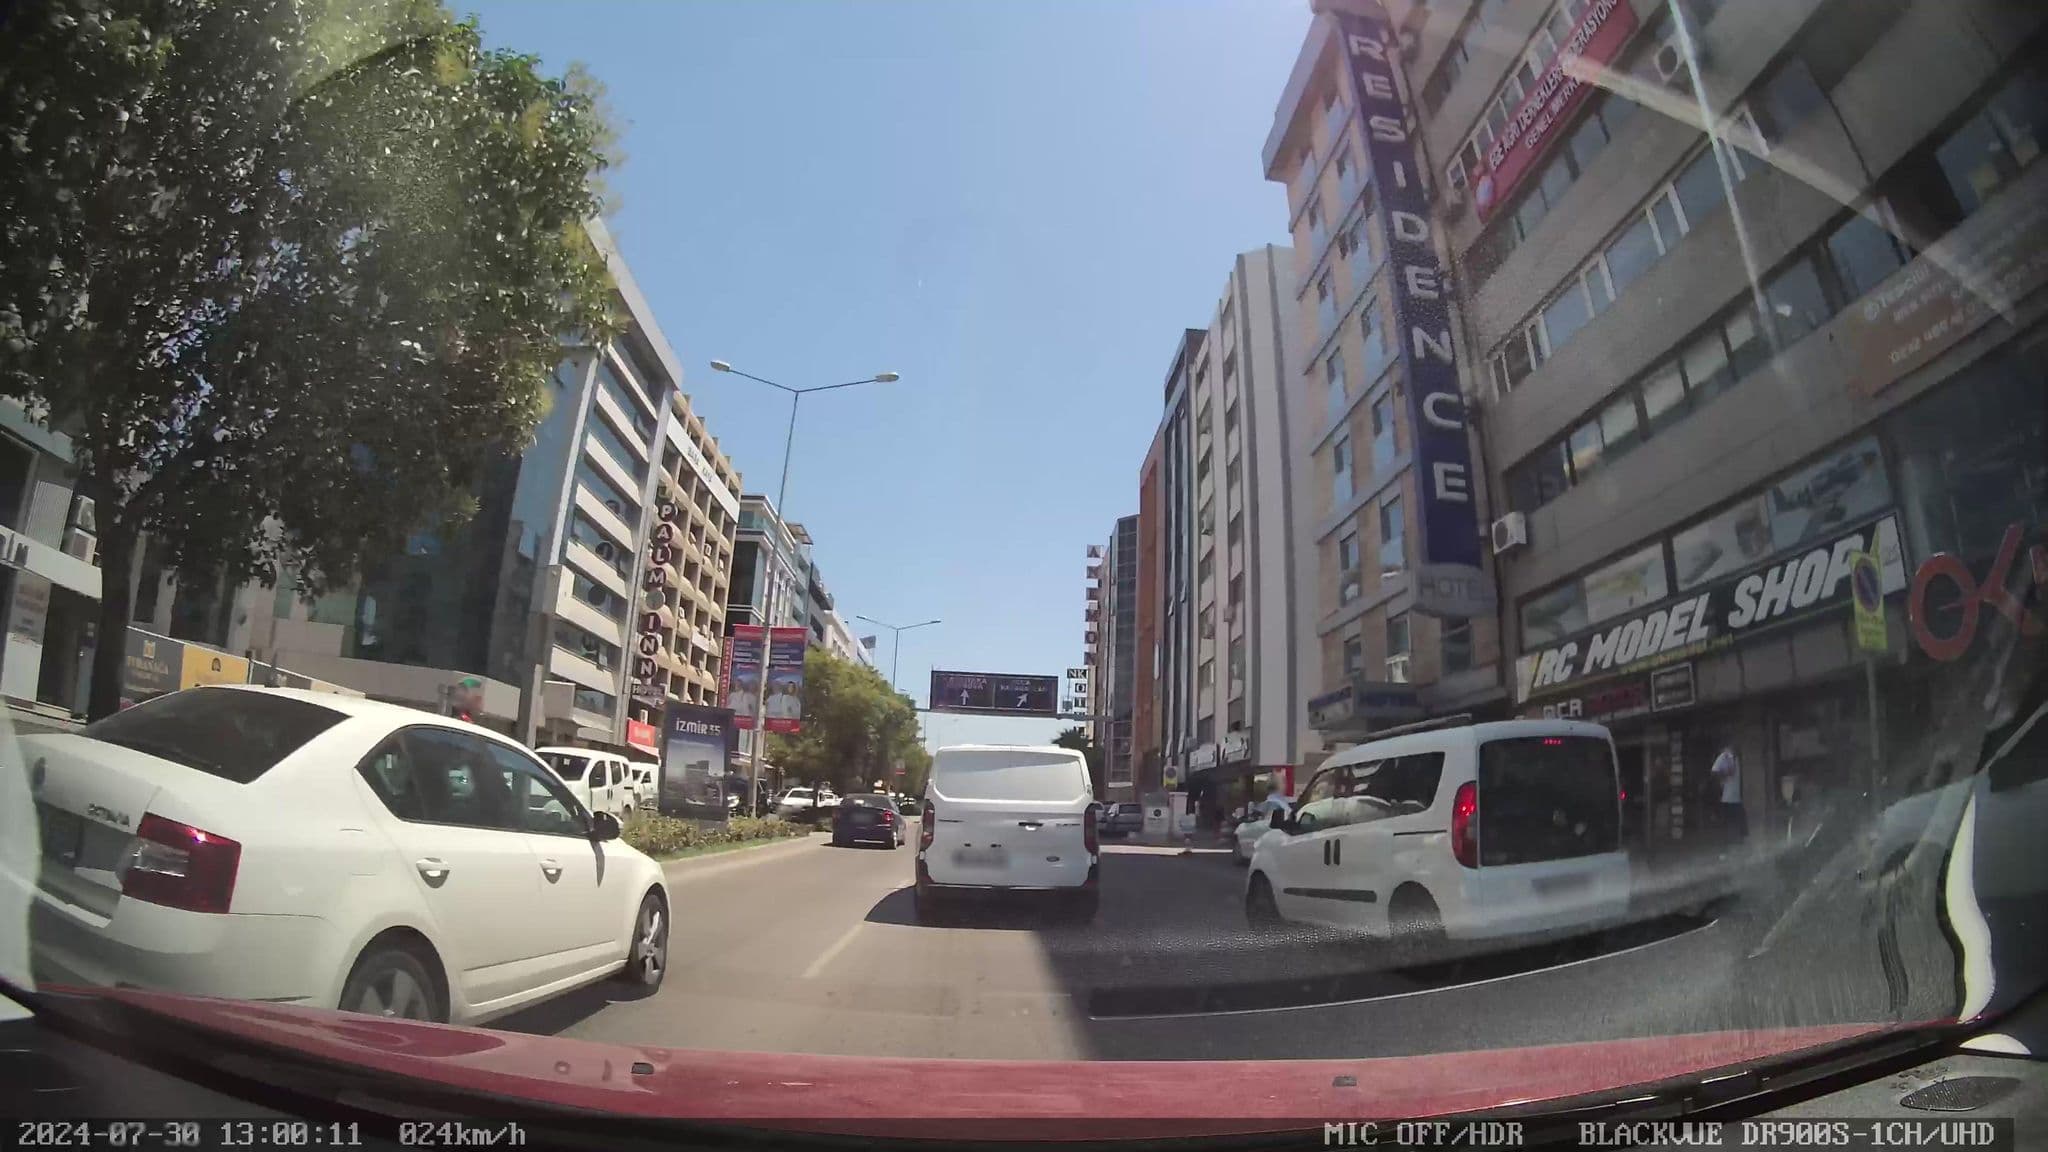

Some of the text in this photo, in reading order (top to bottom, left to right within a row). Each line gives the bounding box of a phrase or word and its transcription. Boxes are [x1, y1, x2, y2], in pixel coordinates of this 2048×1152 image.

[1349, 34, 1468, 502] RESIDENCE
[648, 504, 674, 586] PALM
[639, 613, 657, 676] INN
[1533, 642, 1578, 689] RC
[1582, 593, 1710, 676] MODEL
[1728, 533, 1865, 629] SHOP
